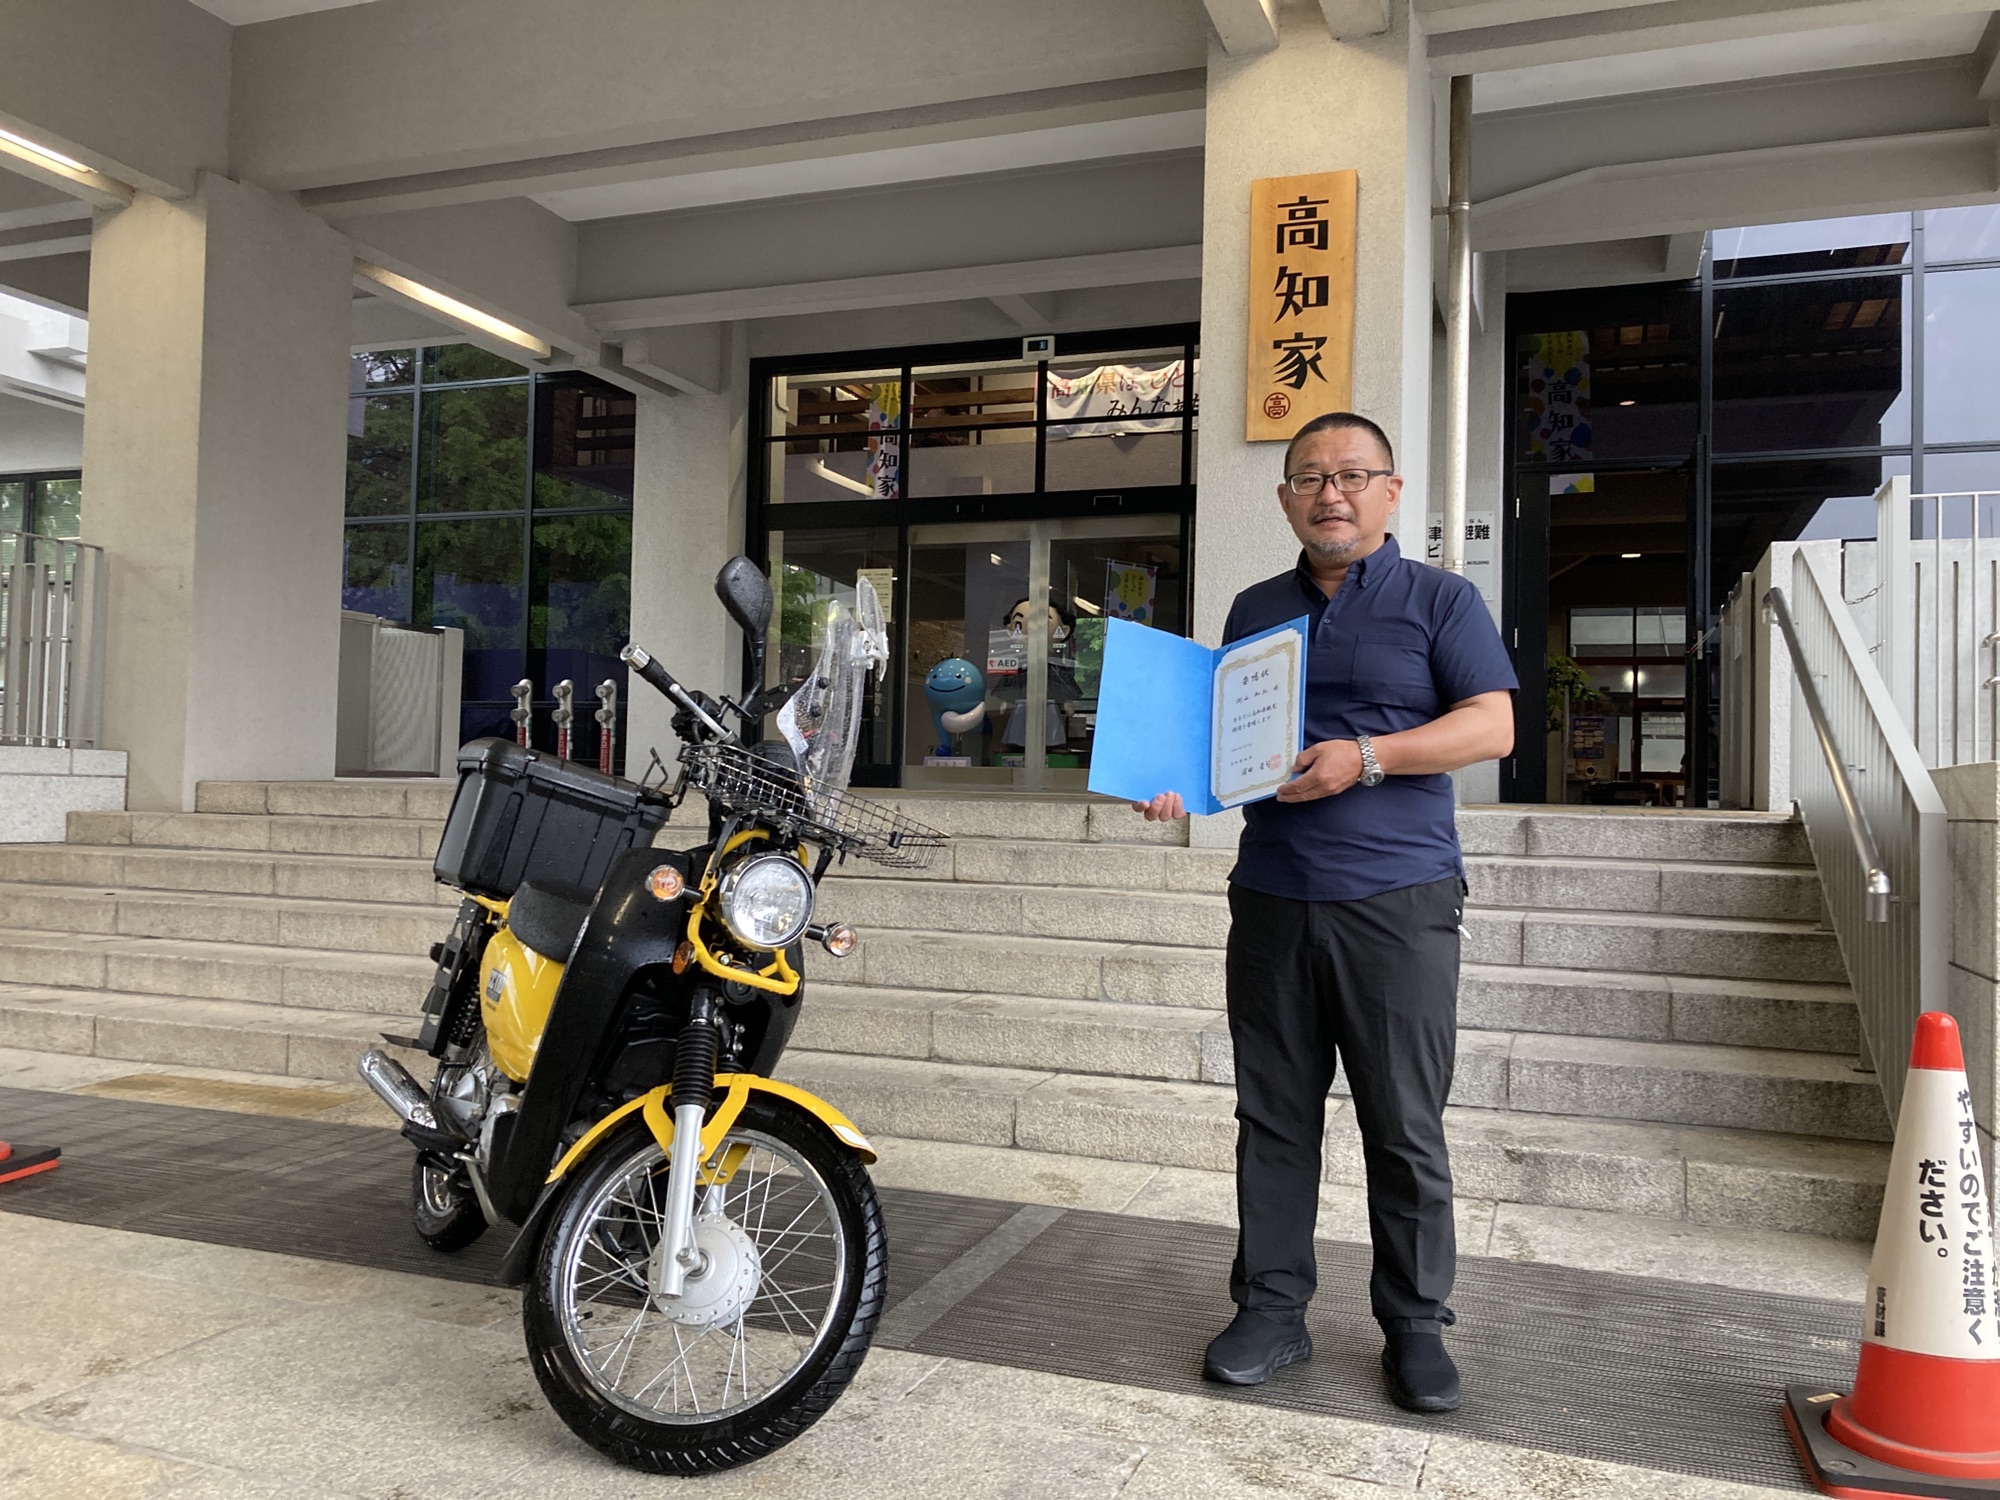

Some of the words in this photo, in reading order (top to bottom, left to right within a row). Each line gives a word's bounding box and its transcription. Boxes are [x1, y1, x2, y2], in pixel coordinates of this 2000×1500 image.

[1273, 196, 1329, 390] 高知家
[878, 424, 898, 496] 高知家
[1547, 380, 1573, 460] 高知家
[997, 659, 1017, 668] AED
[1918, 1158, 1948, 1258] ださい。
[1957, 1088, 1986, 1345] やすいのでご注意く
